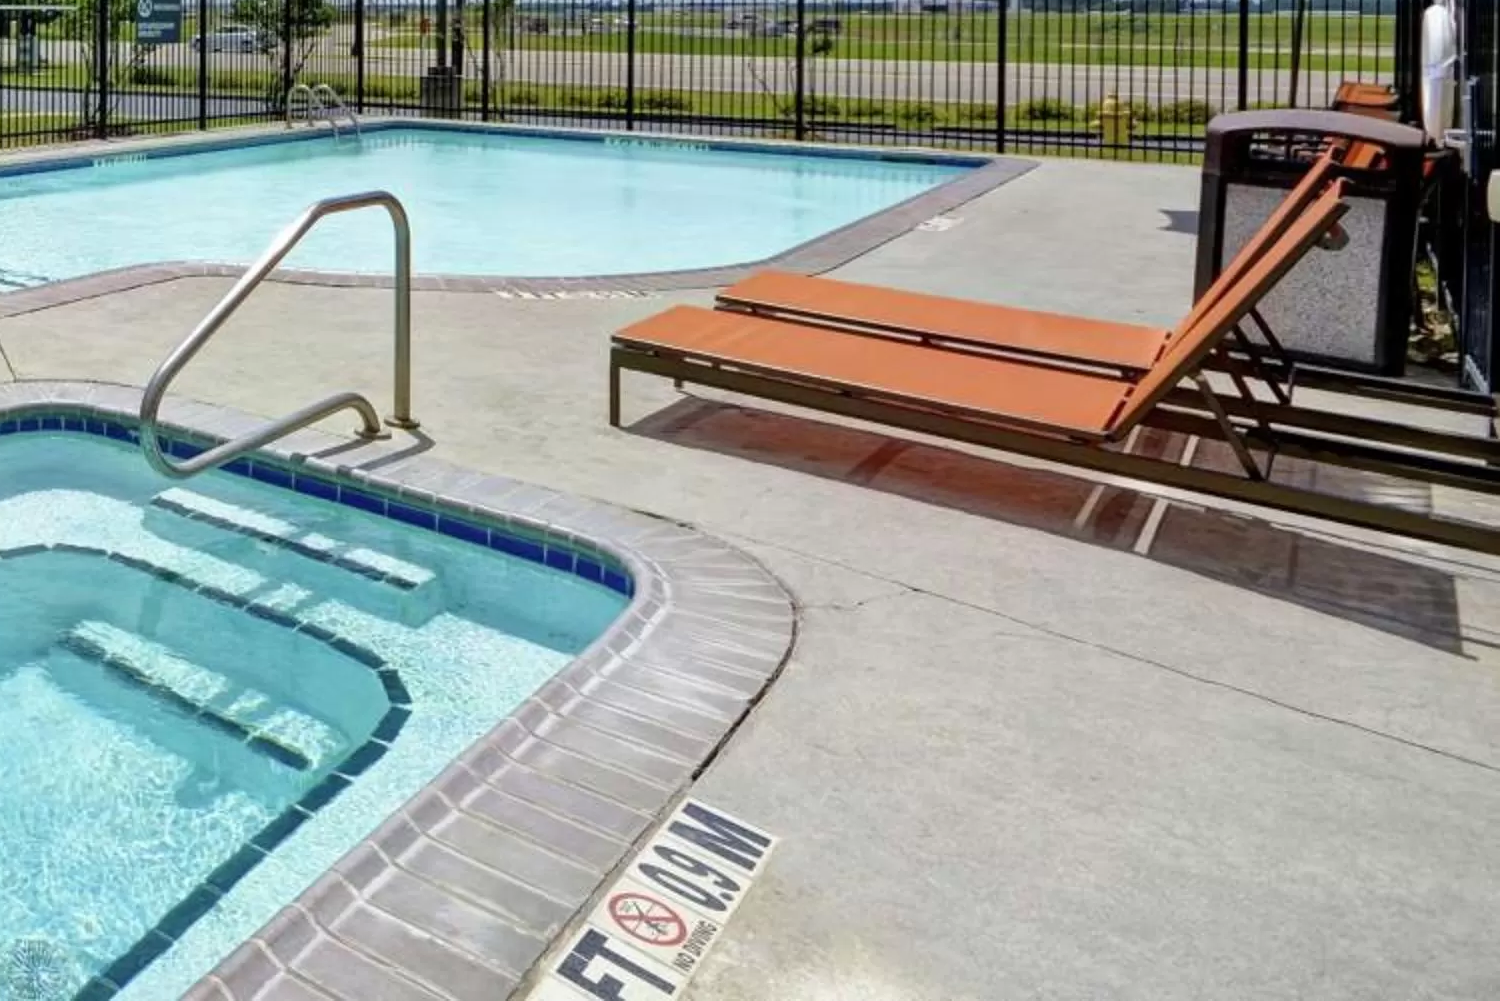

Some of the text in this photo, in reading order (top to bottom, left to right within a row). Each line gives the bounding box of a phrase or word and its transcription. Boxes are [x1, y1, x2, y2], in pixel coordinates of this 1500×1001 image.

[668, 802, 772, 872] M
[638, 844, 741, 912] 0.9
[673, 920, 718, 972] NO DIVING
